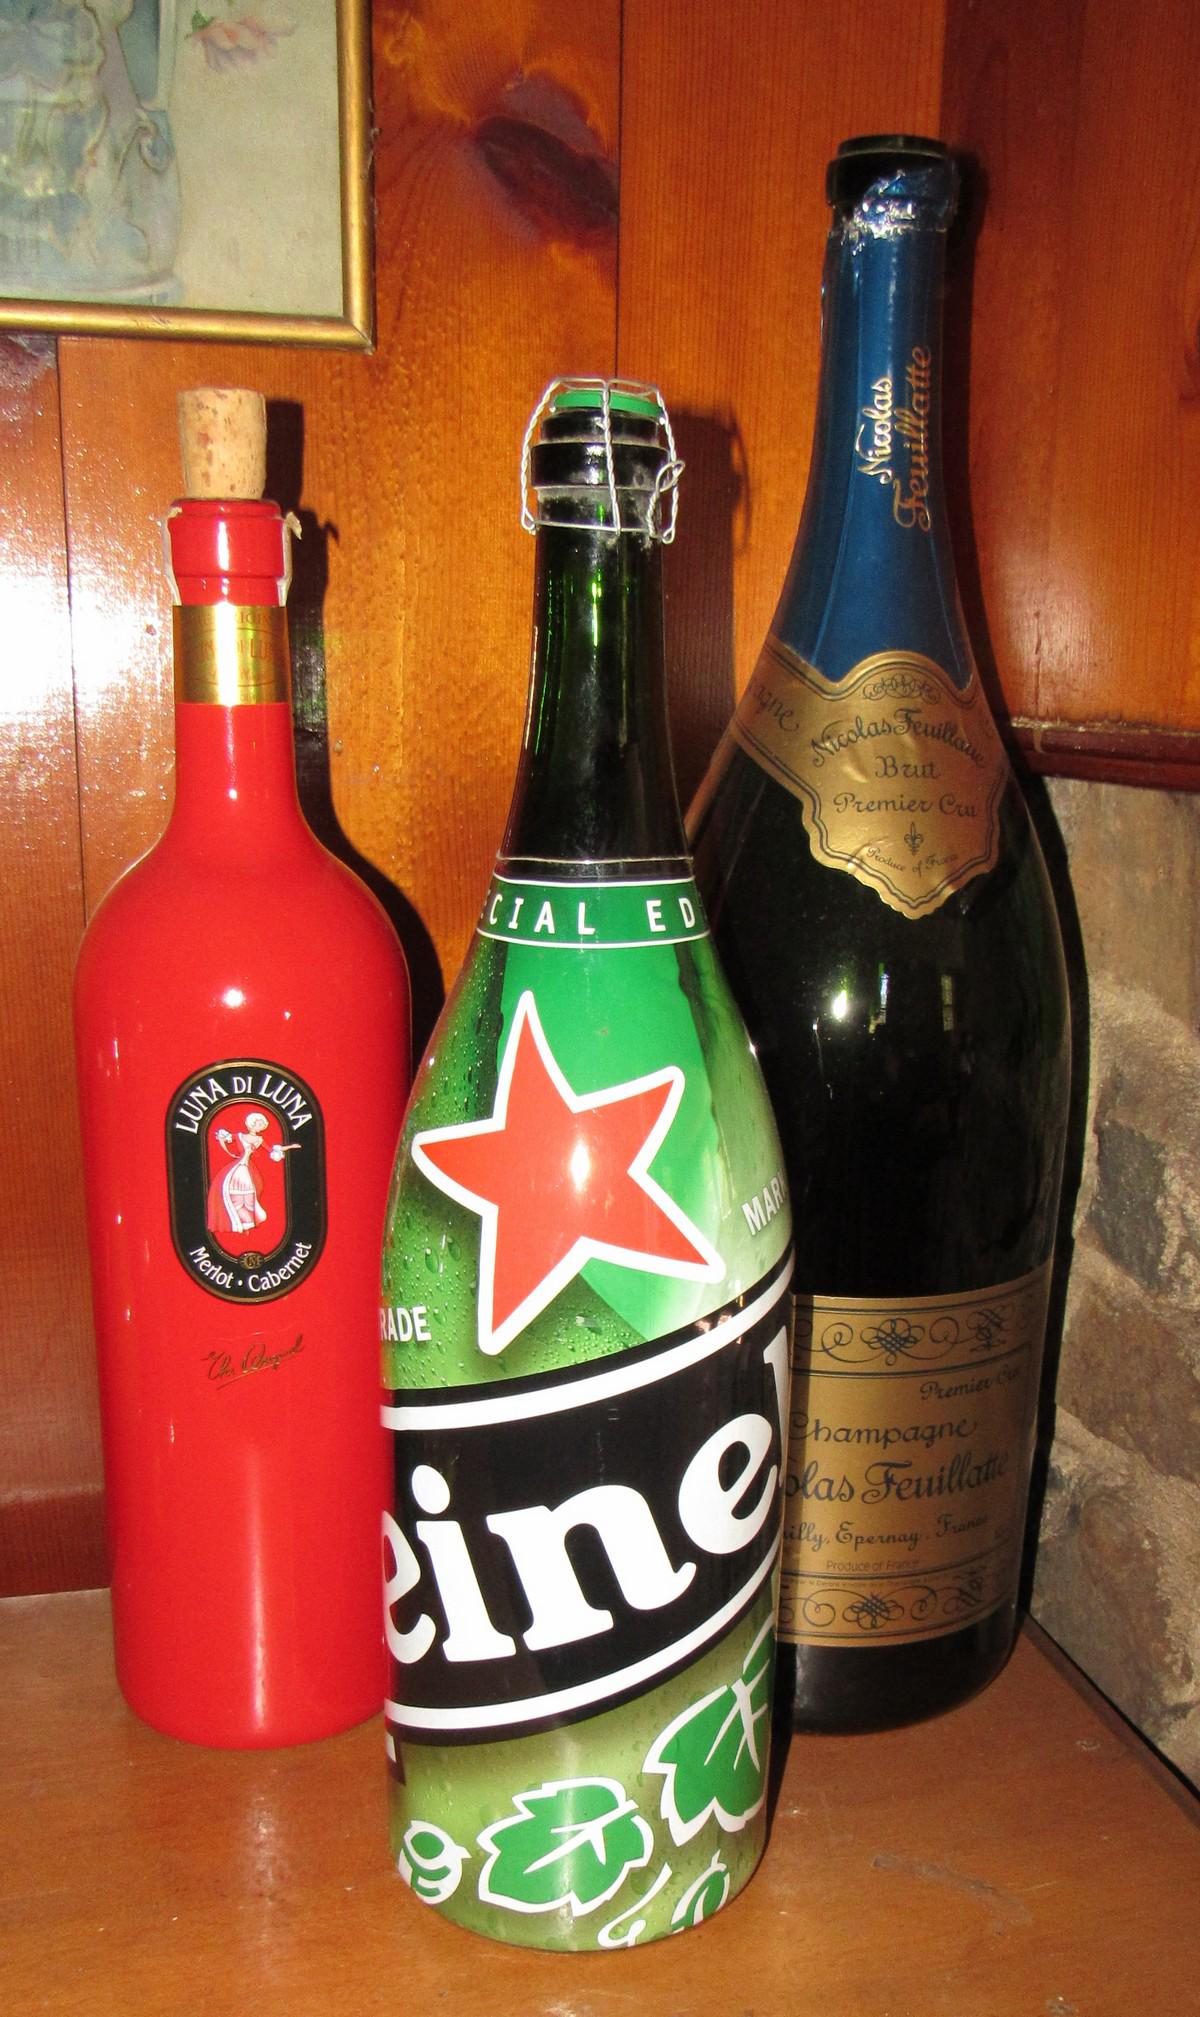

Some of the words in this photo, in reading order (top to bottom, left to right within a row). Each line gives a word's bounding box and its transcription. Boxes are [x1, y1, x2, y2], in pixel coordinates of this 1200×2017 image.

[855, 376, 894, 484] Nicolas
[893, 345, 932, 532] Feuillatte
[810, 715, 893, 768] Nicolas
[875, 755, 941, 780] Brut
[833, 792, 933, 816] Premier
[939, 793, 978, 818] Cru
[866, 847, 907, 872] Produce
[912, 862, 923, 878] of
[481, 893, 596, 935] CIAL
[175, 1077, 227, 1135] LUNA
[232, 1076, 253, 1095] DI
[258, 1073, 314, 1131] LUNA
[188, 1246, 234, 1290] Merlot
[248, 1241, 313, 1293] Cabernet
[379, 1304, 432, 1342] RADE
[920, 1379, 993, 1400] Premier
[790, 1411, 978, 1449] Champagne
[836, 1520, 921, 1551] Epernay
[826, 1559, 871, 1572] Produce
[872, 1559, 884, 1571] of
